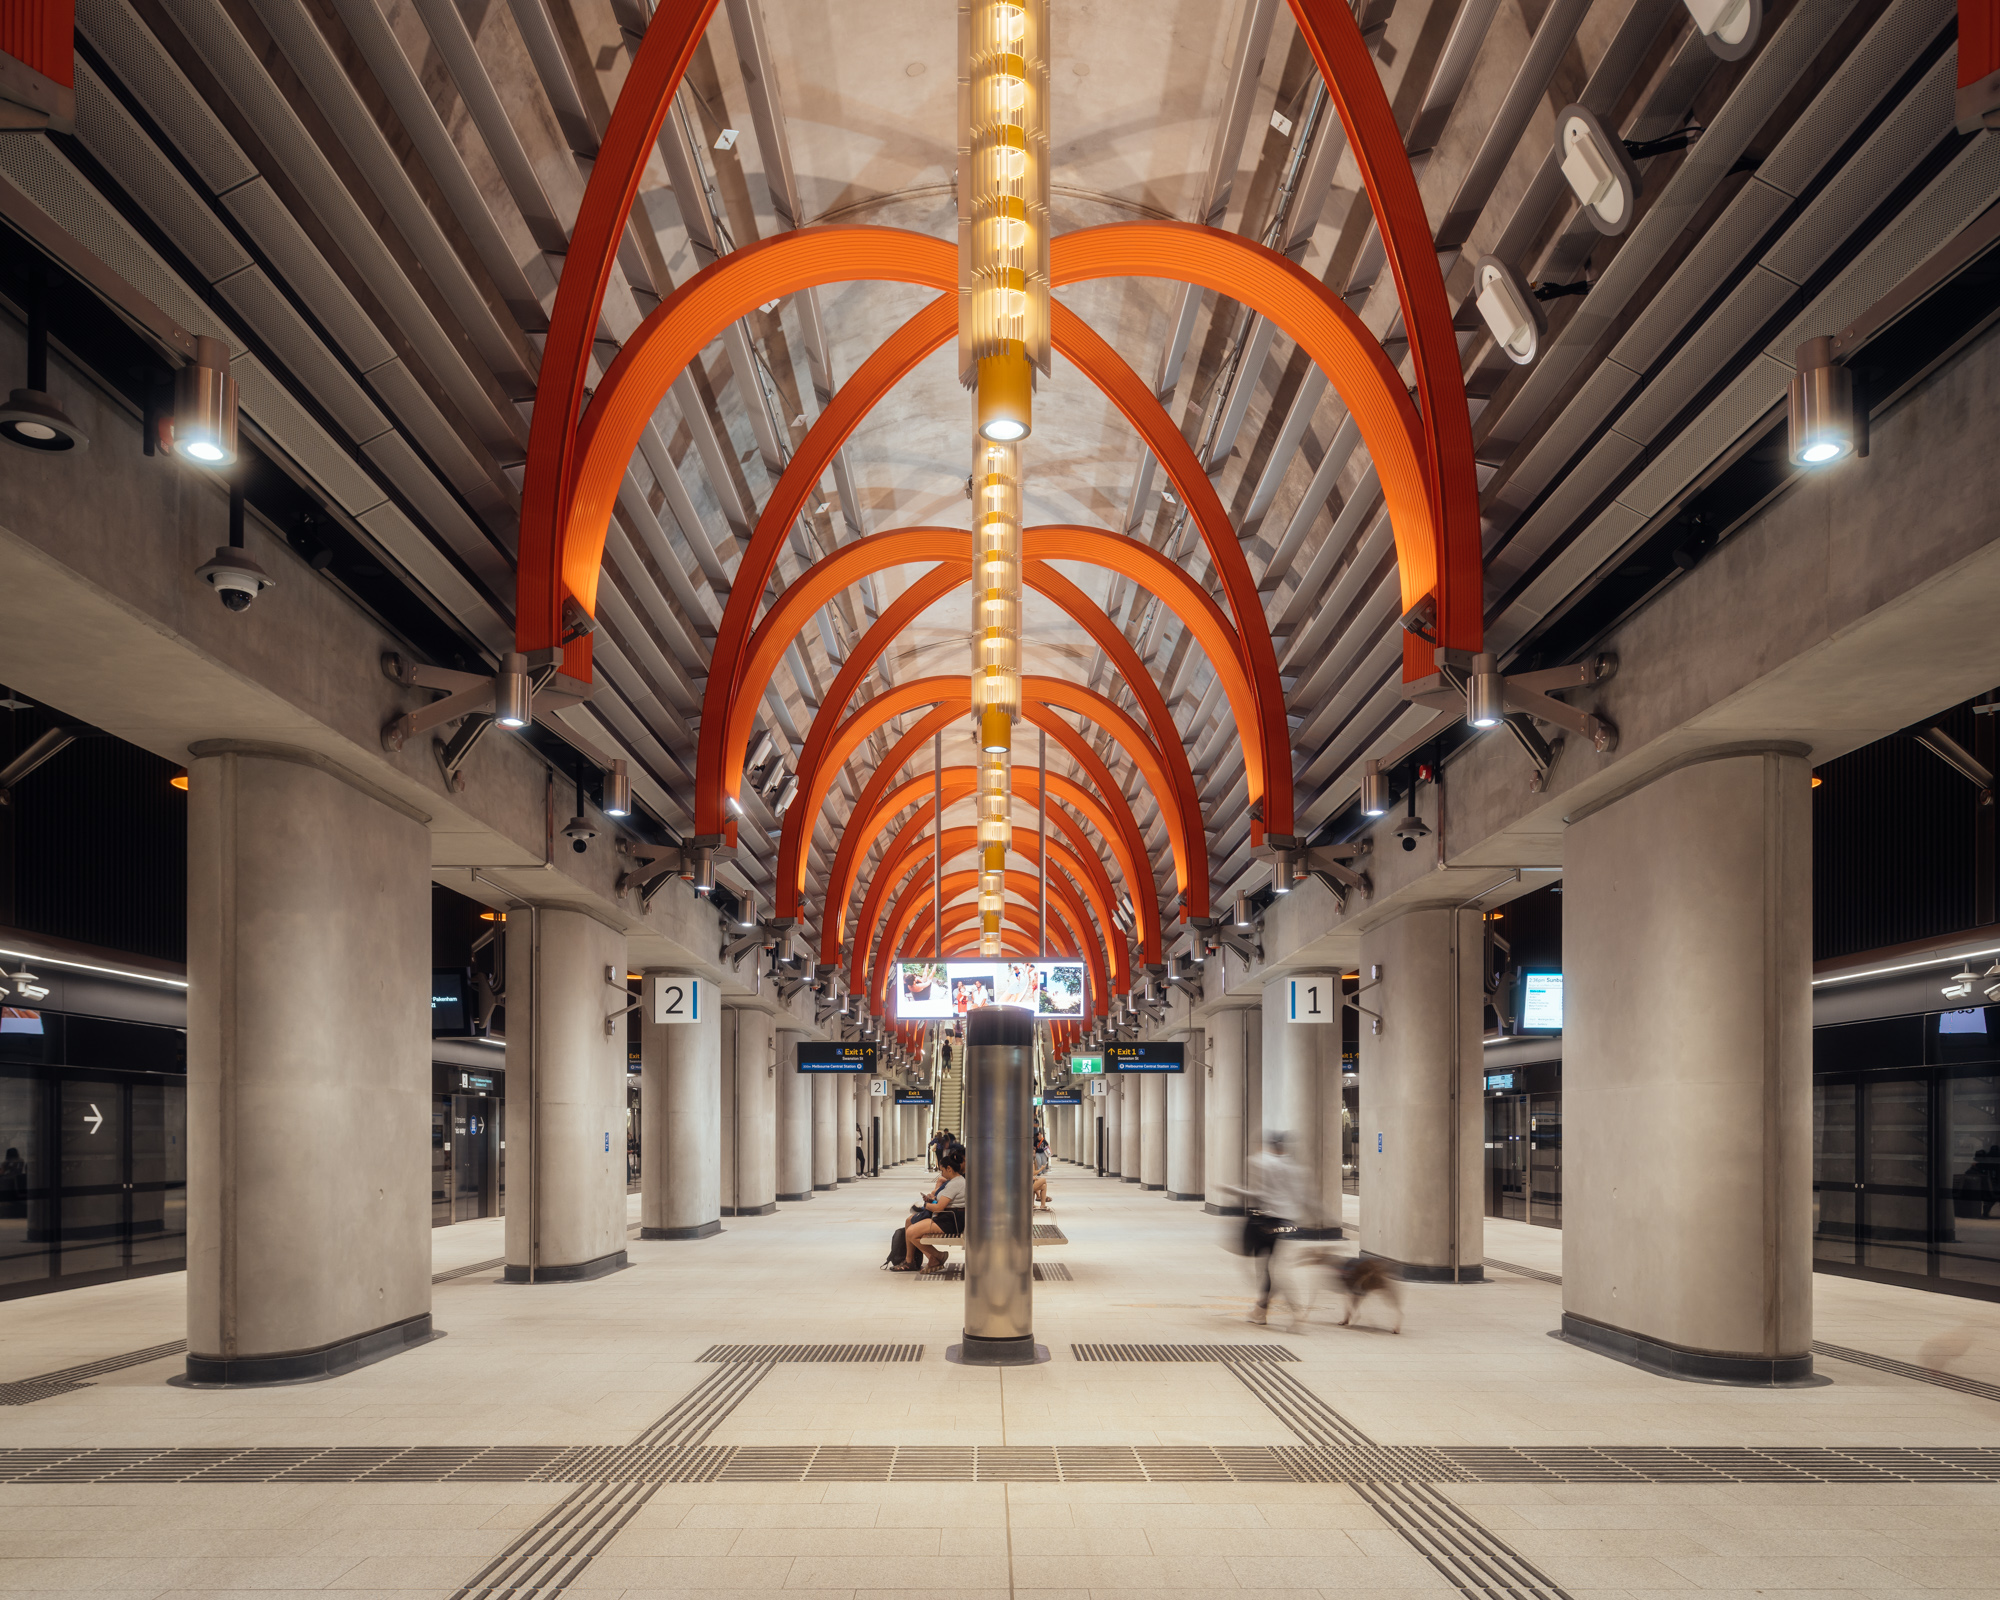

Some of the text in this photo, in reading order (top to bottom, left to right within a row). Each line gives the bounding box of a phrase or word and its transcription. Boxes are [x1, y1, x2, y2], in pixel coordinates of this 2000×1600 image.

[665, 986, 683, 1014] 2
[1308, 986, 1321, 1014] 1
[874, 1082, 881, 1092] 2
[1098, 1082, 1103, 1092] 1
